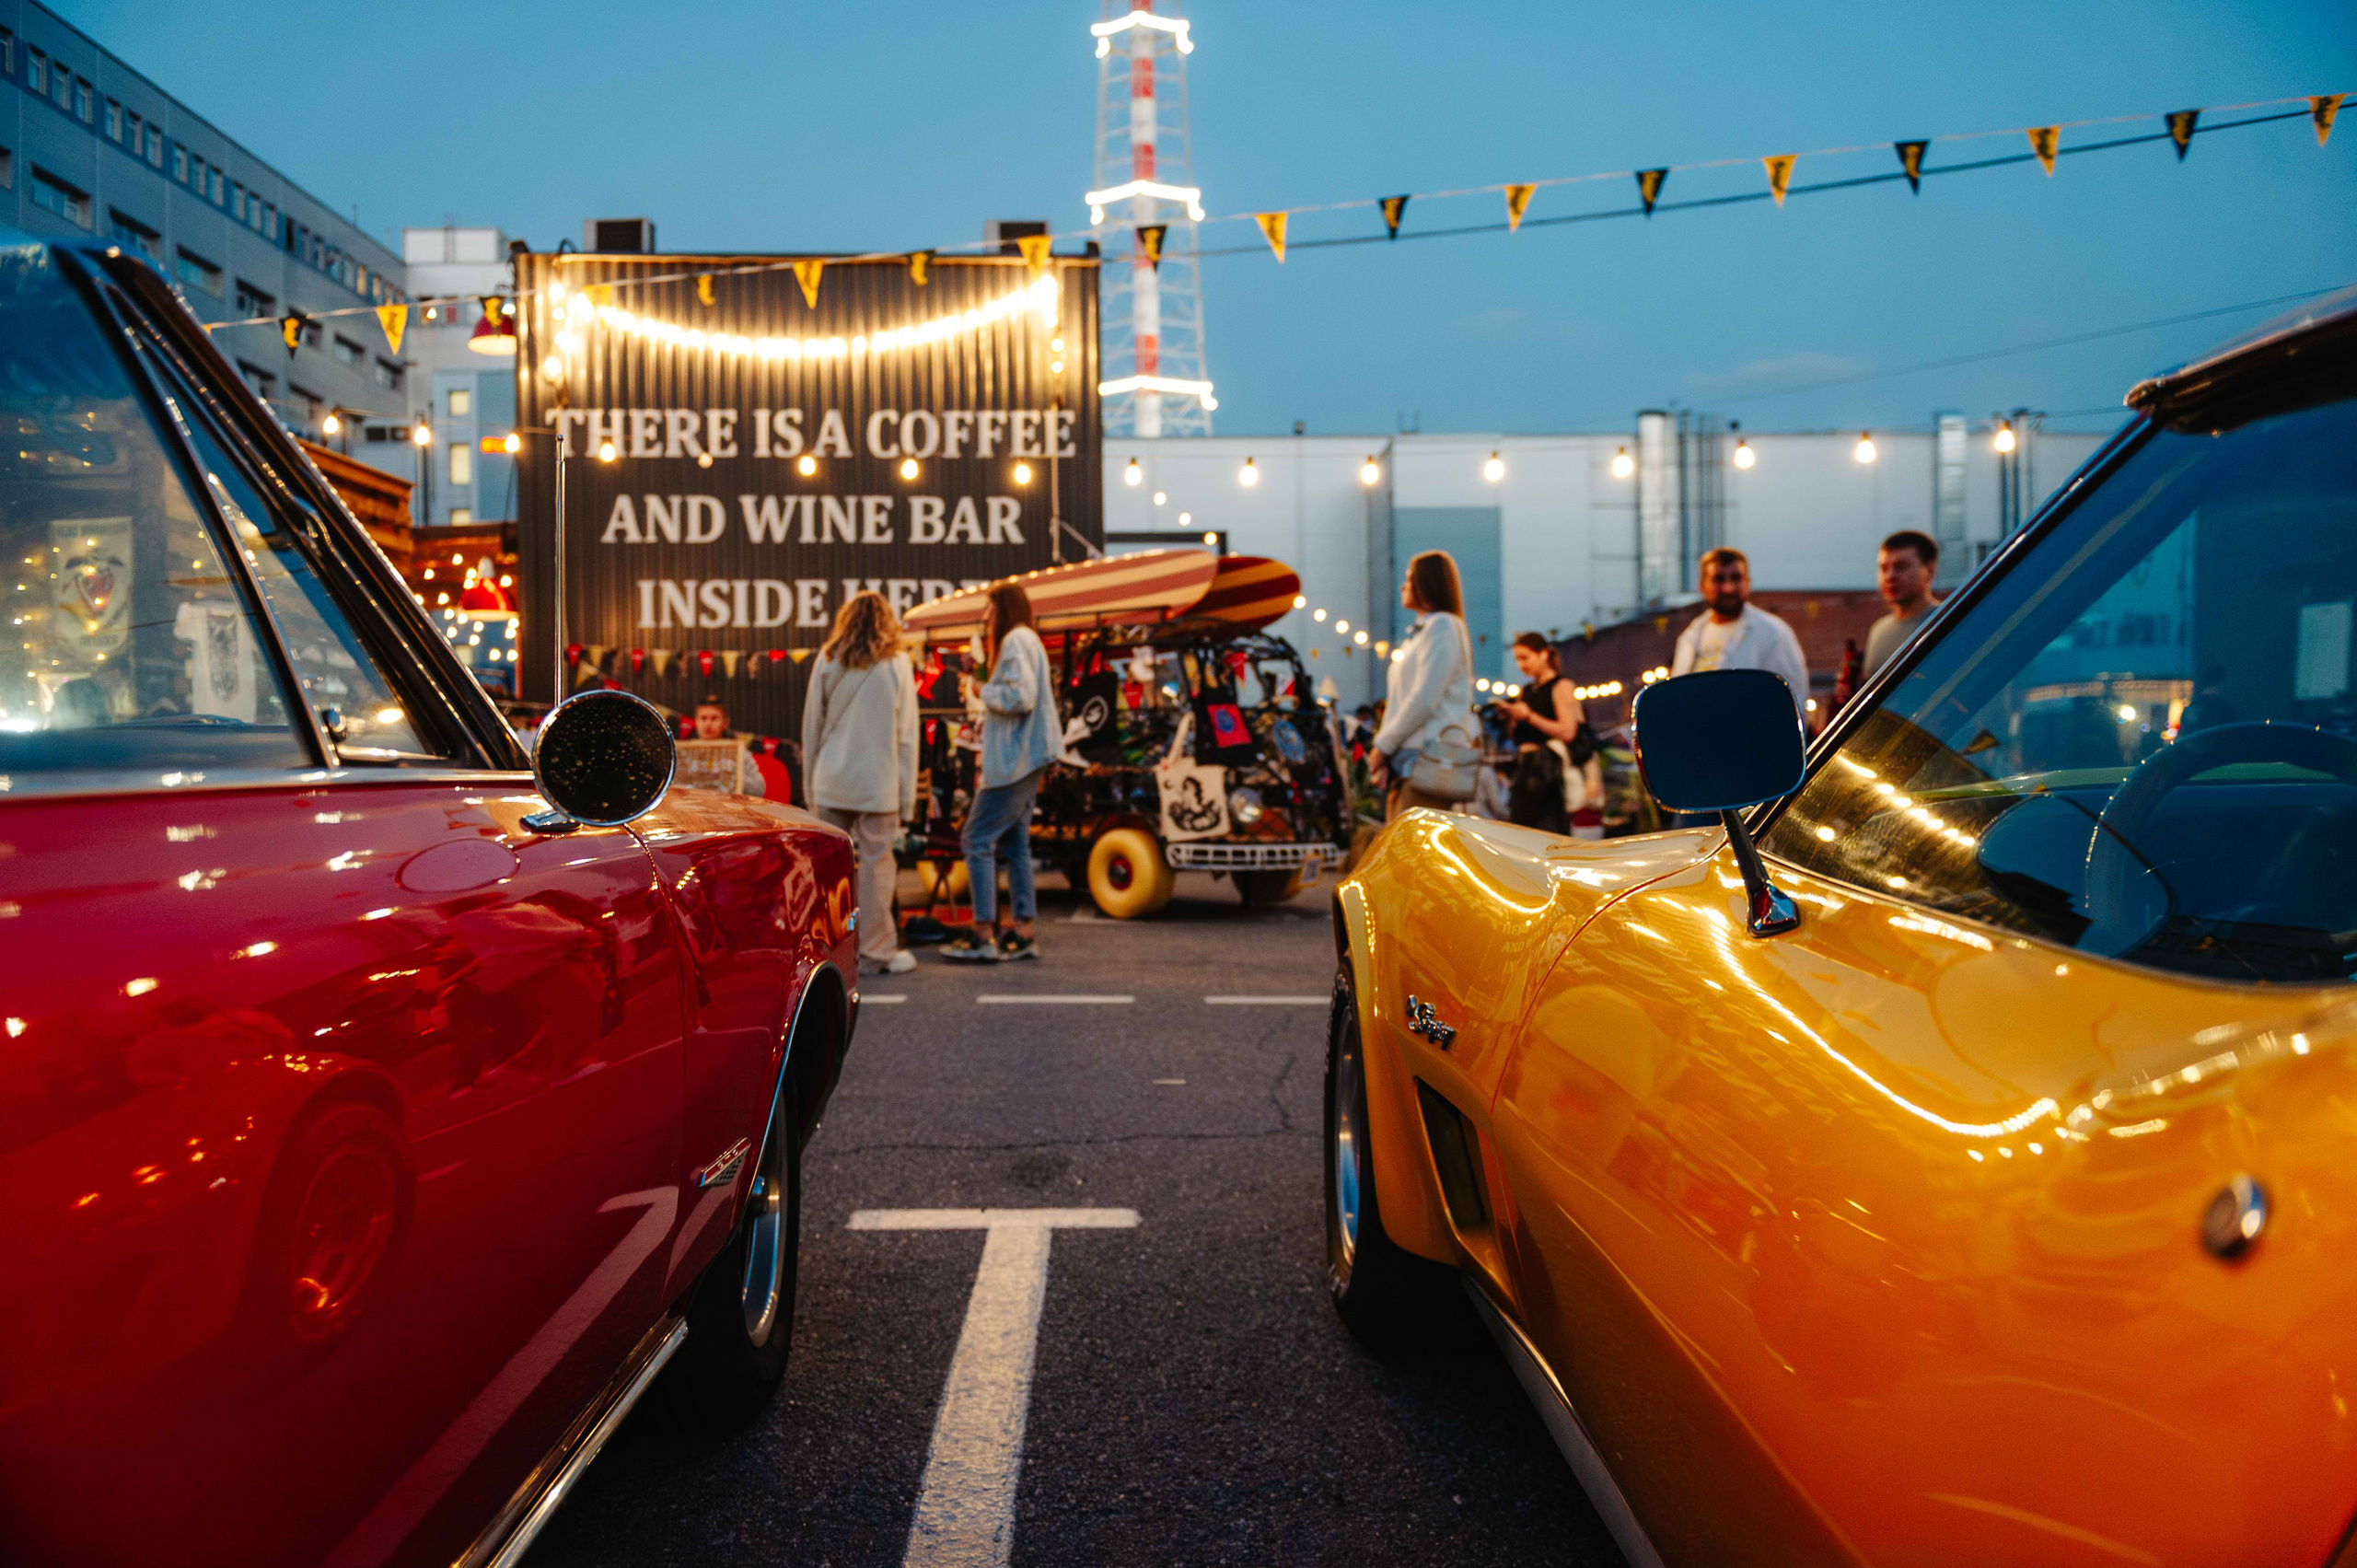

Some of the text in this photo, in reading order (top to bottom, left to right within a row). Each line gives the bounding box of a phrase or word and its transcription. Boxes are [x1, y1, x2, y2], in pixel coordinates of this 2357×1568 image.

[545, 408, 1077, 459] THERE IS A COFFEE
[599, 494, 1026, 544] AND WINE BAR
[637, 578, 994, 630] INSIDE ER
